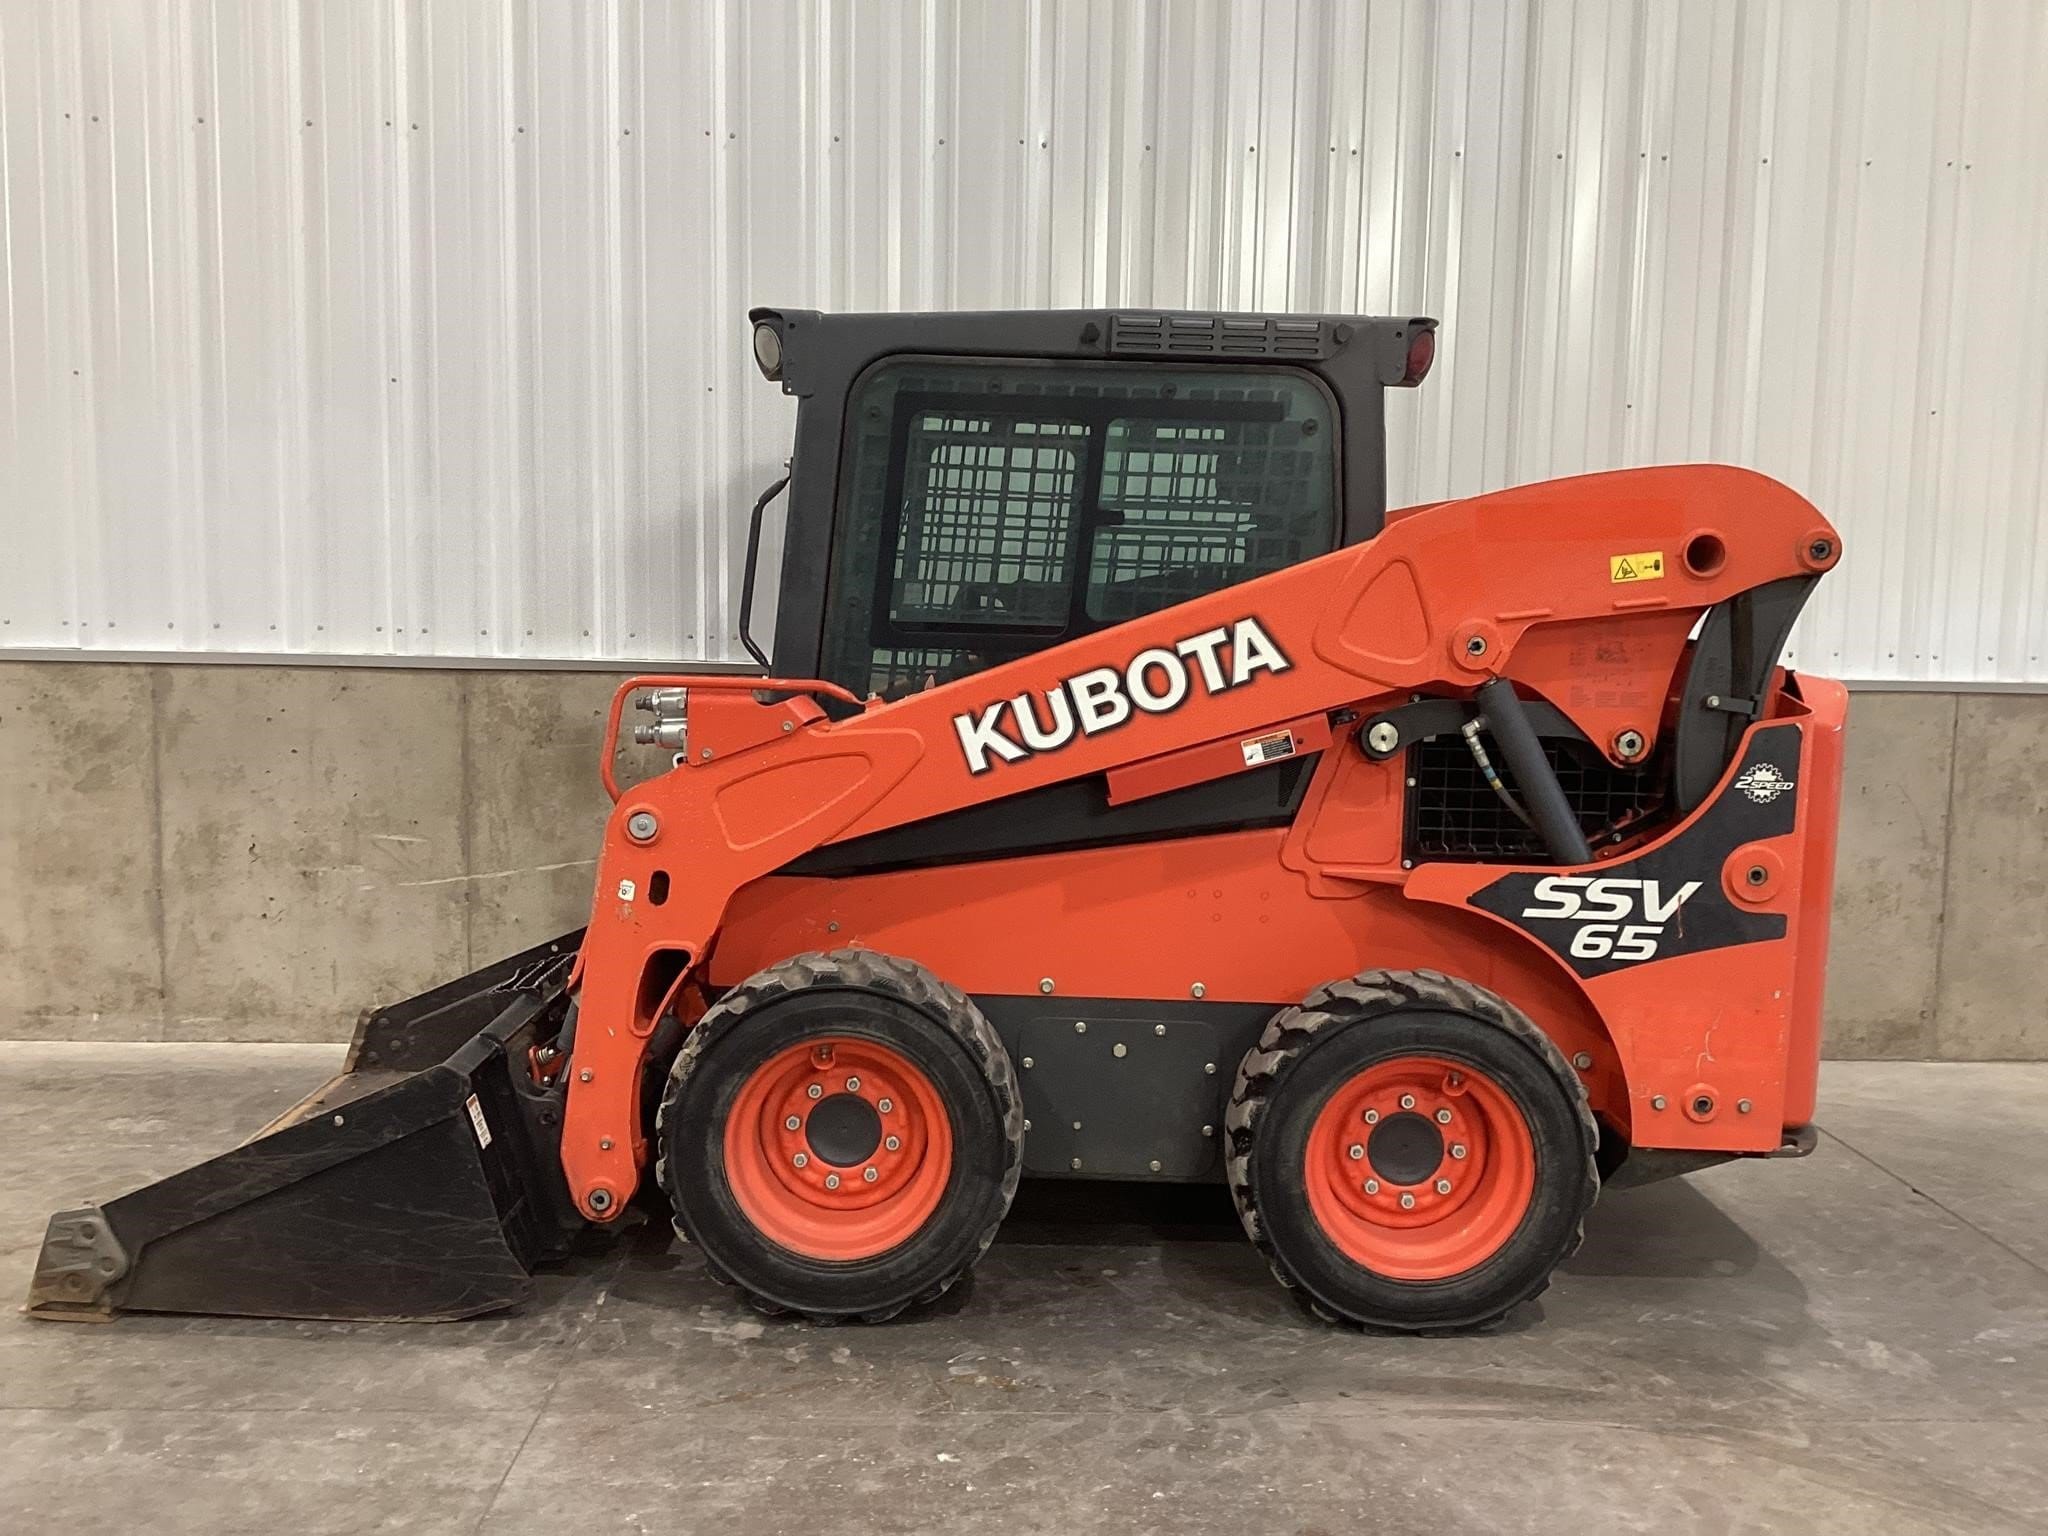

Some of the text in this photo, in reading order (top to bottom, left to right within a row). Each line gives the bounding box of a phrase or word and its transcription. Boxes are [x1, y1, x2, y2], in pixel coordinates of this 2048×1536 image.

[953, 617, 1290, 774] KUBOTA
[1521, 877, 1704, 923] SSV
[1569, 924, 1665, 961] 65
